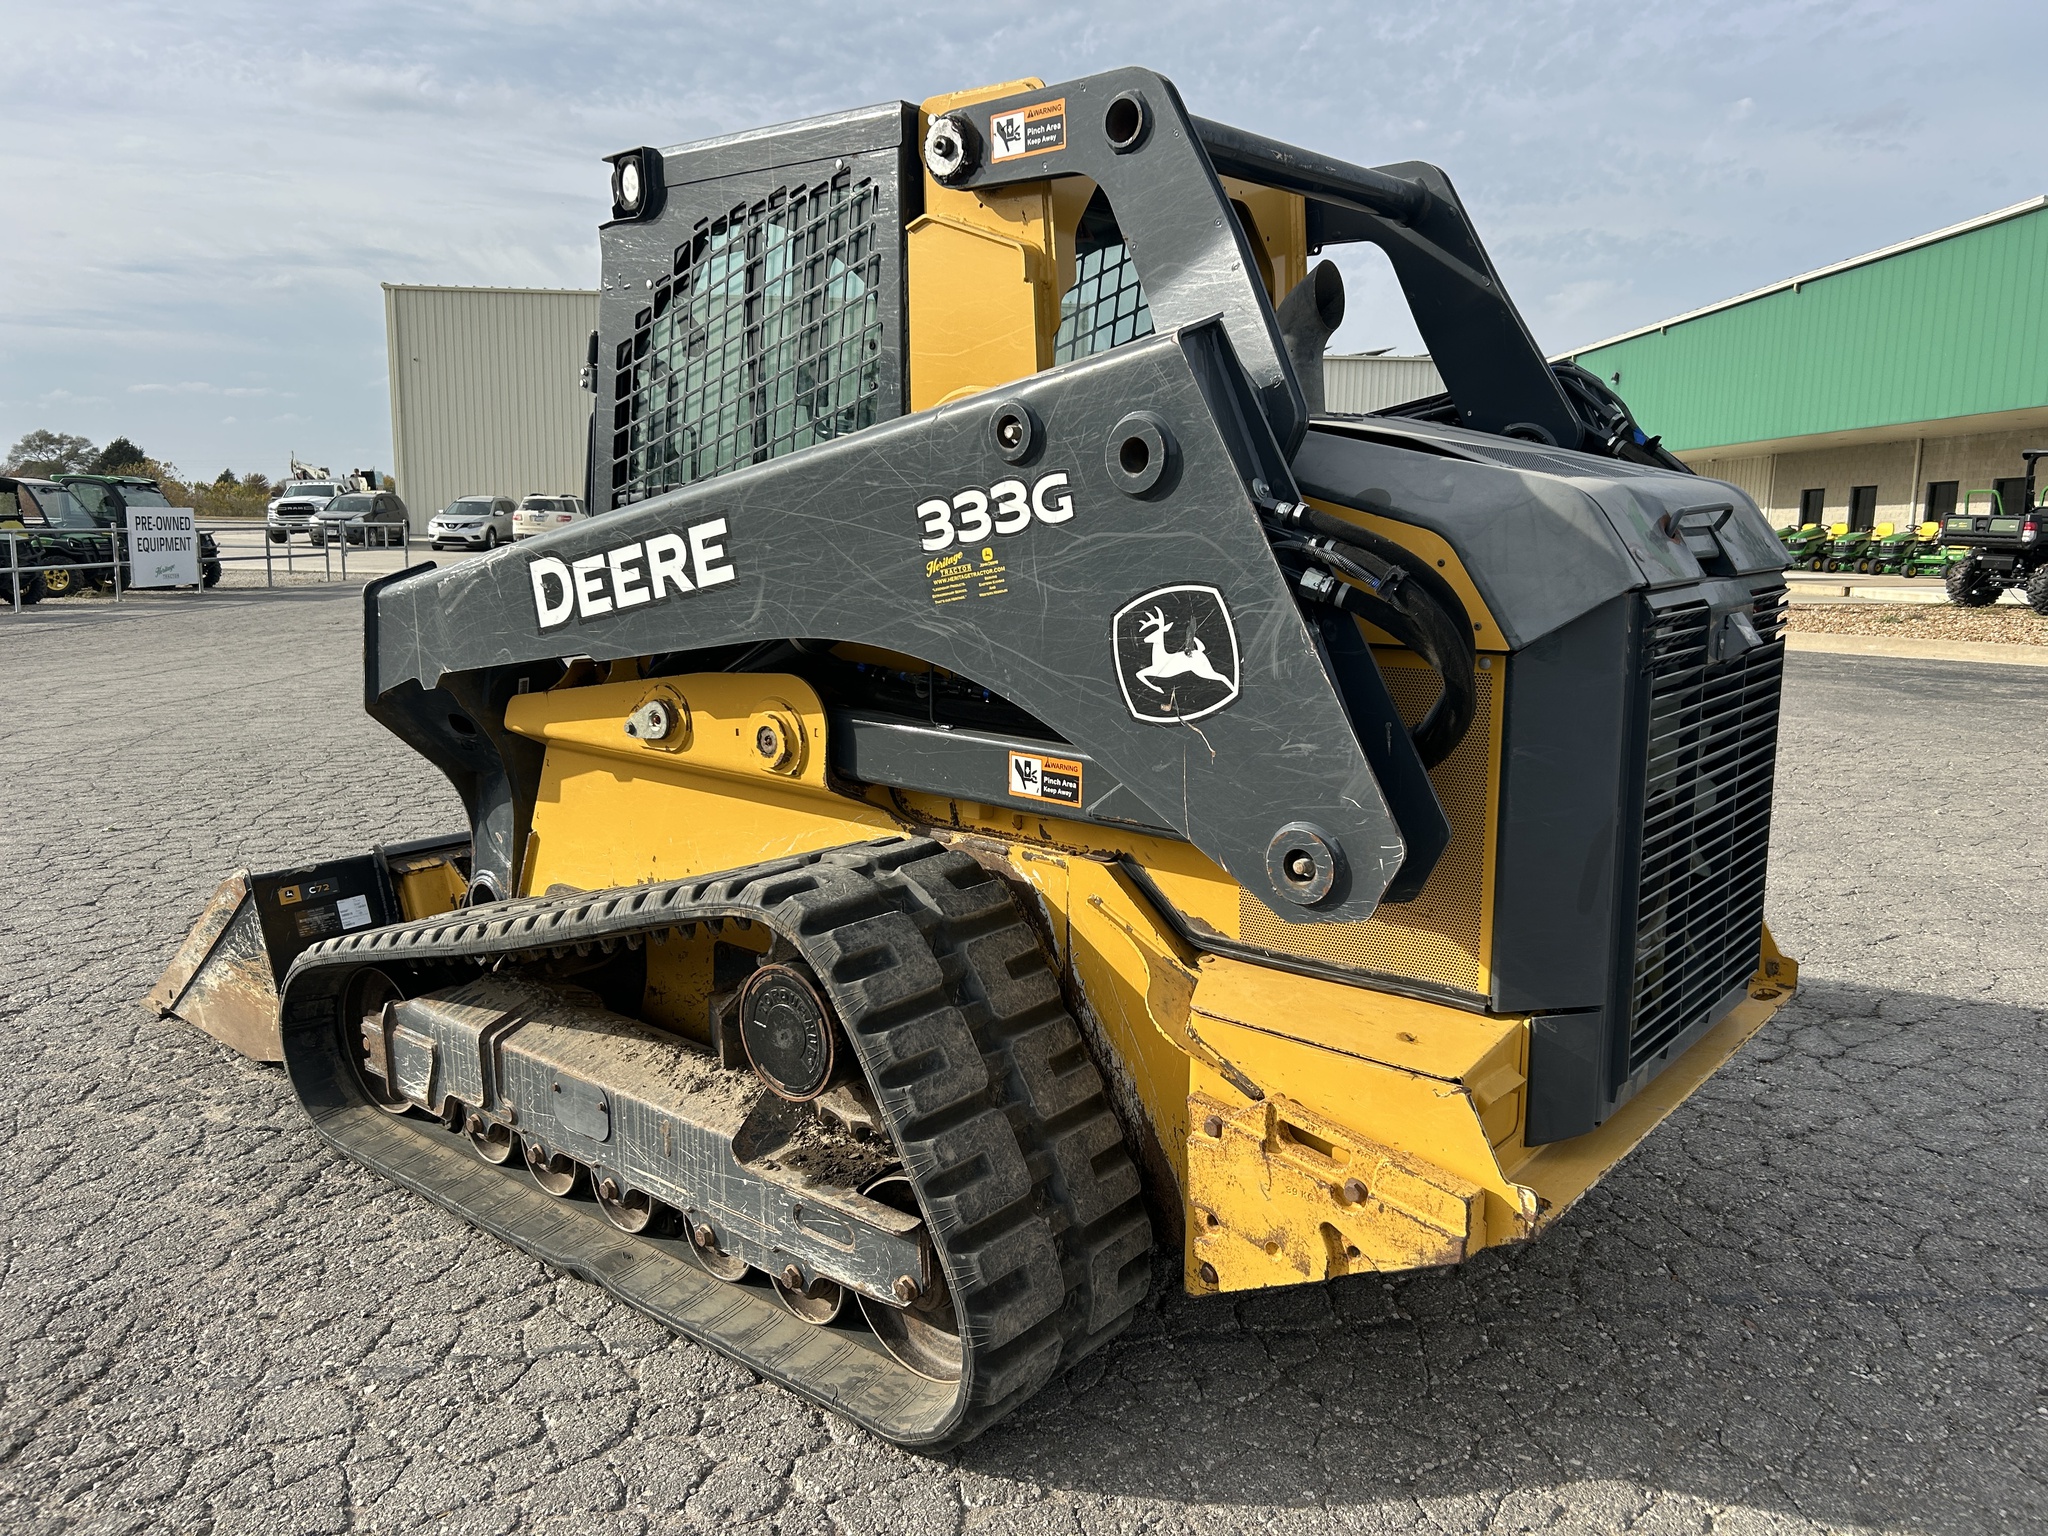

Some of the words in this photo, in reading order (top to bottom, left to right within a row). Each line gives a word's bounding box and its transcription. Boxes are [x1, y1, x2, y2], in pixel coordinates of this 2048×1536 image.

[1033, 104, 1062, 117] WARNING
[1027, 124, 1046, 136] Pinch
[1046, 122, 1061, 132] Area
[1027, 137, 1041, 146] Keep
[1041, 134, 1057, 143] Away
[917, 473, 1074, 551] 333G
[135, 516, 191, 531] PRE-OWNED
[137, 537, 191, 553] EQUIPMENT
[926, 551, 963, 577] Heritage
[941, 564, 972, 577] TRACTOR
[529, 517, 735, 628] DEERE
[1050, 763, 1079, 773] WARNING
[1043, 776, 1061, 786] Pinch
[1061, 779, 1077, 789] Area
[1043, 786, 1057, 795] Keep
[1057, 788, 1073, 798] Away
[308, 884, 330, 894] C72
